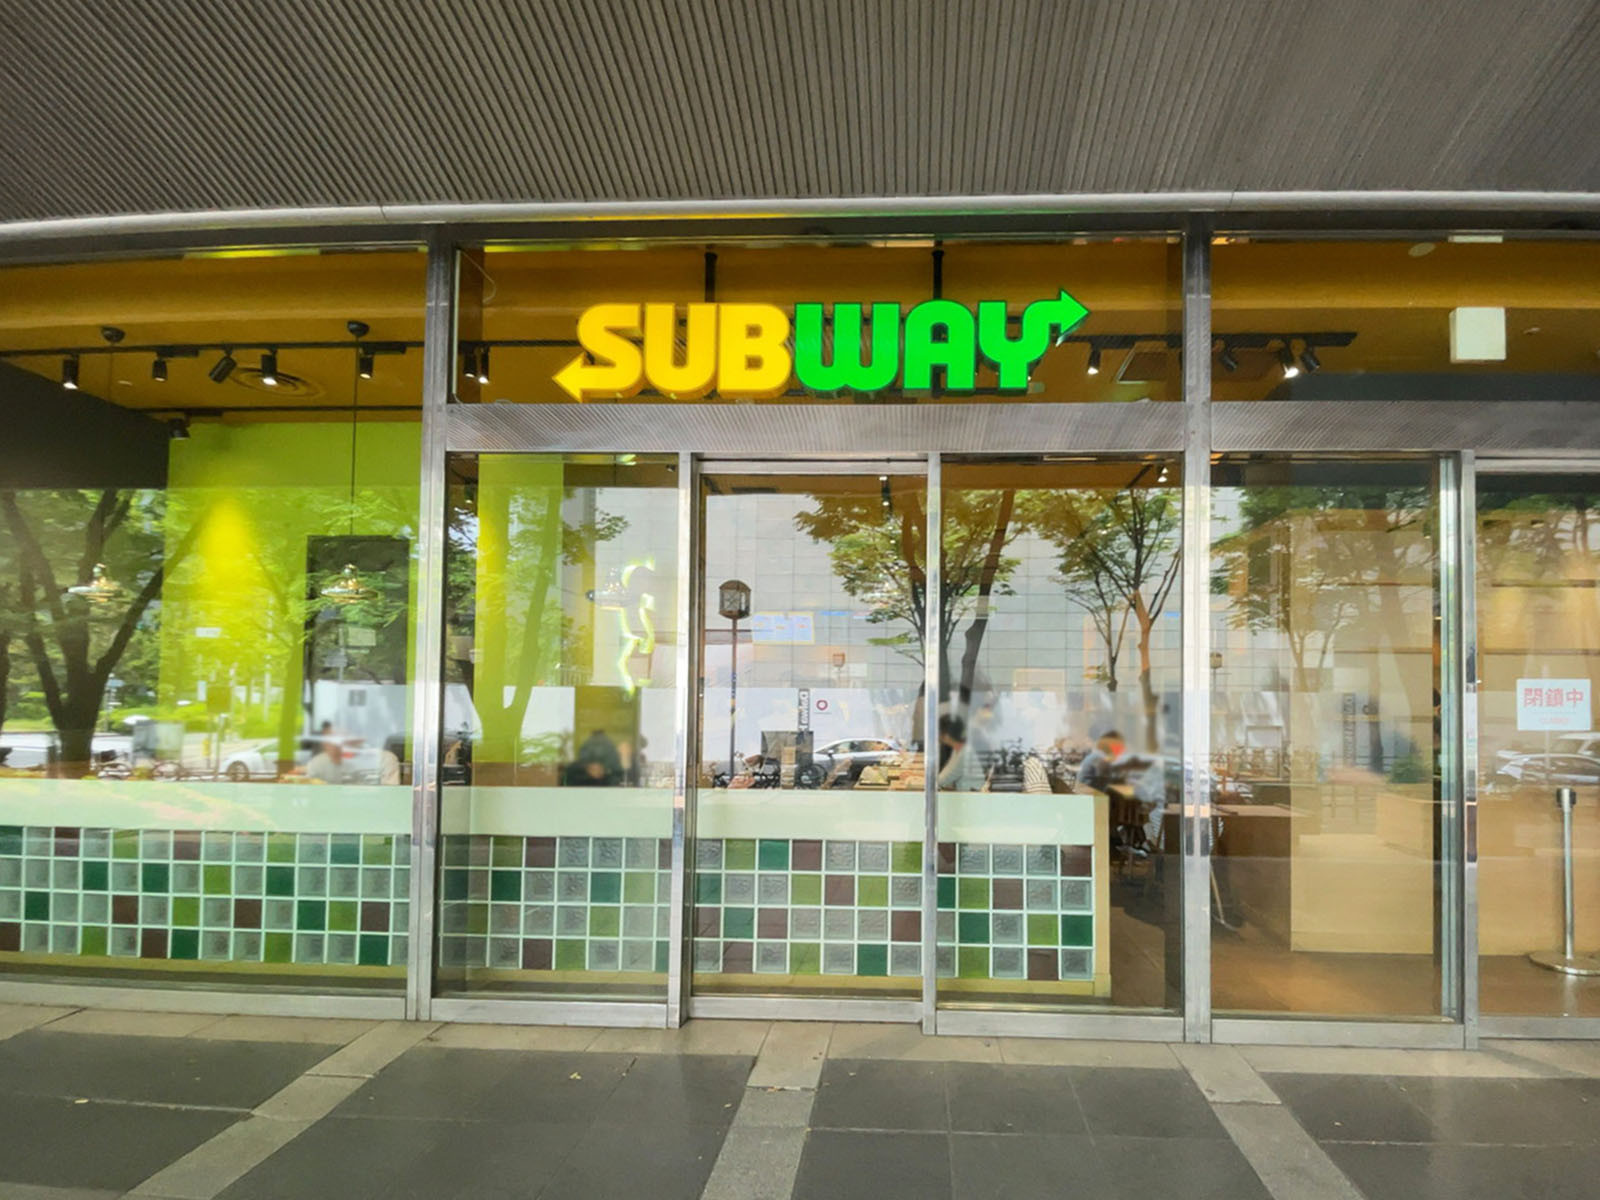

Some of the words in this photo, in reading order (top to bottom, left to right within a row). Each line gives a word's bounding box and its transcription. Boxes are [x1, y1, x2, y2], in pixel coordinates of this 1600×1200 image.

[552, 290, 1090, 402] SUBWAY
[1523, 687, 1584, 708] 閉鎖中
